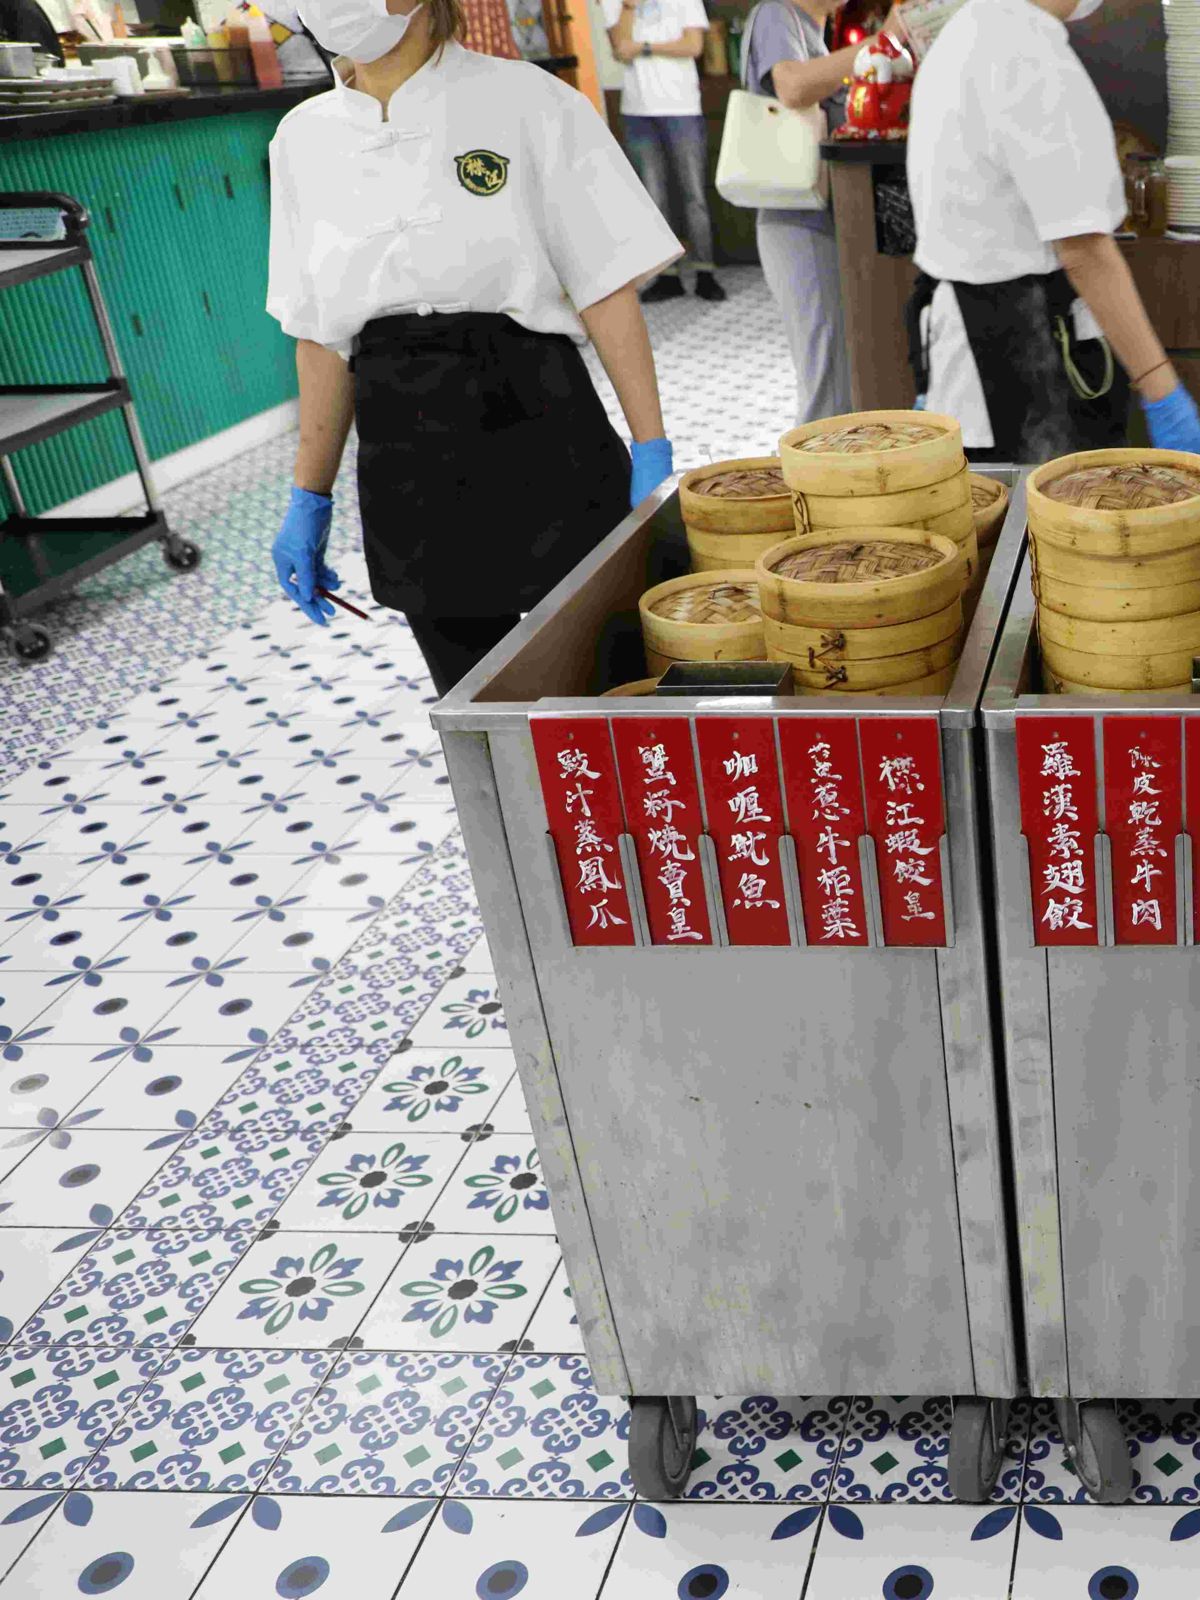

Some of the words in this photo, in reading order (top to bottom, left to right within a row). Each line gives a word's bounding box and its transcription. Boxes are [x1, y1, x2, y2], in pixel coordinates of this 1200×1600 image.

[723, 750, 780, 909] 咖喱魷魚
[1040, 741, 1093, 931] 羅漢素翅餃
